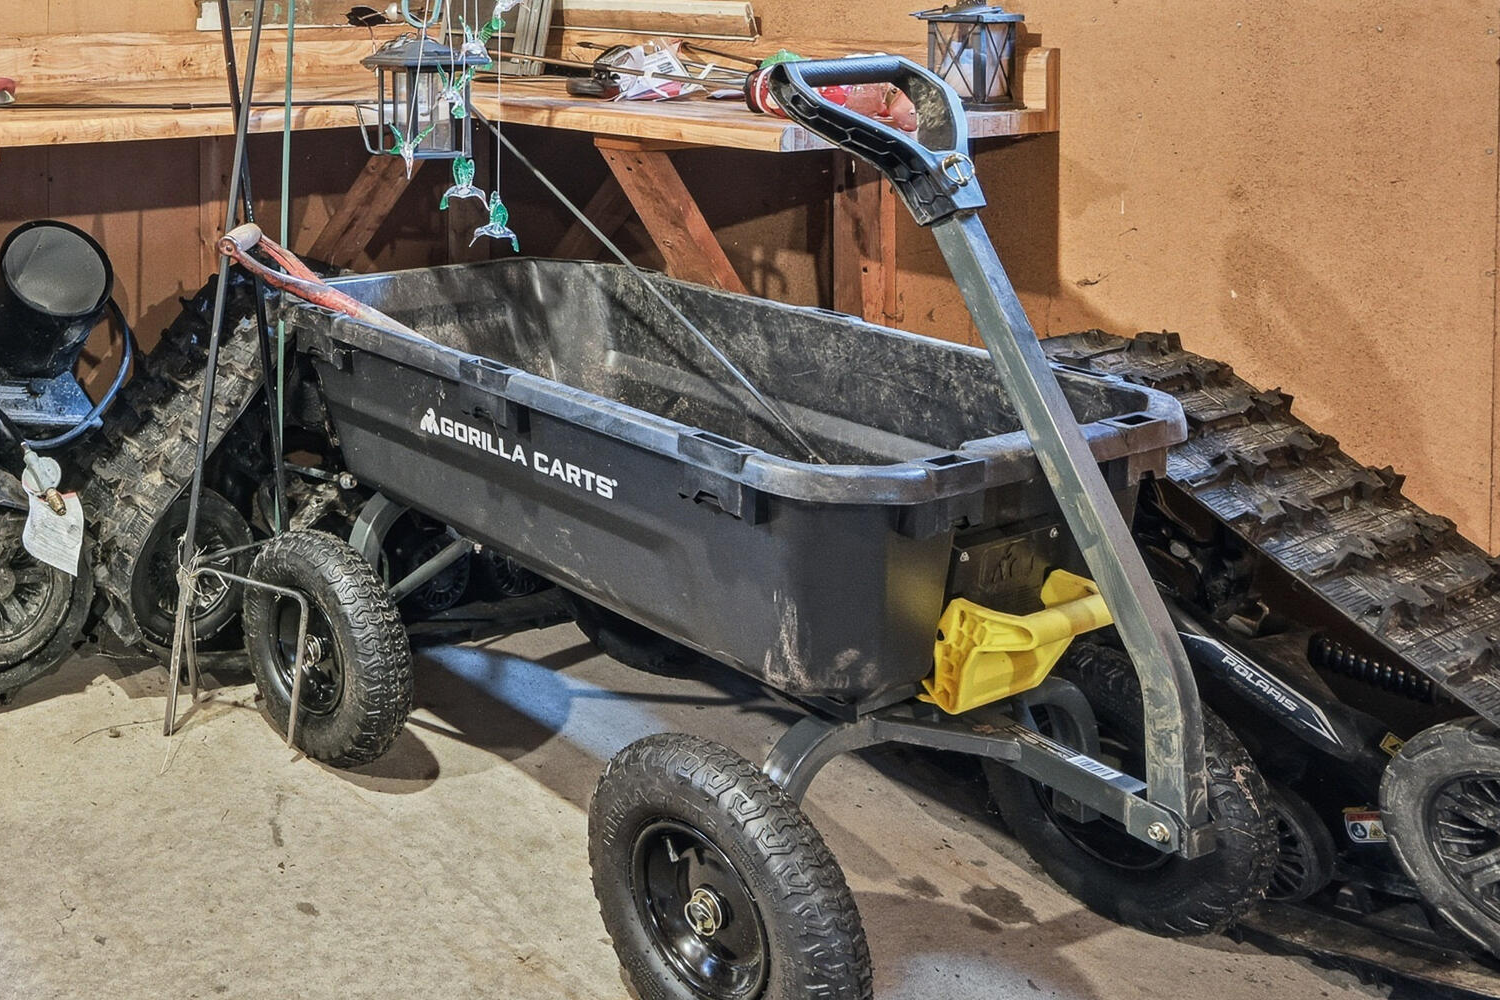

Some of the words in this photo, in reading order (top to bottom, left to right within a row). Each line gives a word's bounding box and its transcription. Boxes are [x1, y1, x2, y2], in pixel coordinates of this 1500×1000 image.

[440, 415, 528, 467] GORILLA
[533, 451, 615, 500] CARTS
[1221, 655, 1300, 712] POLARIS
